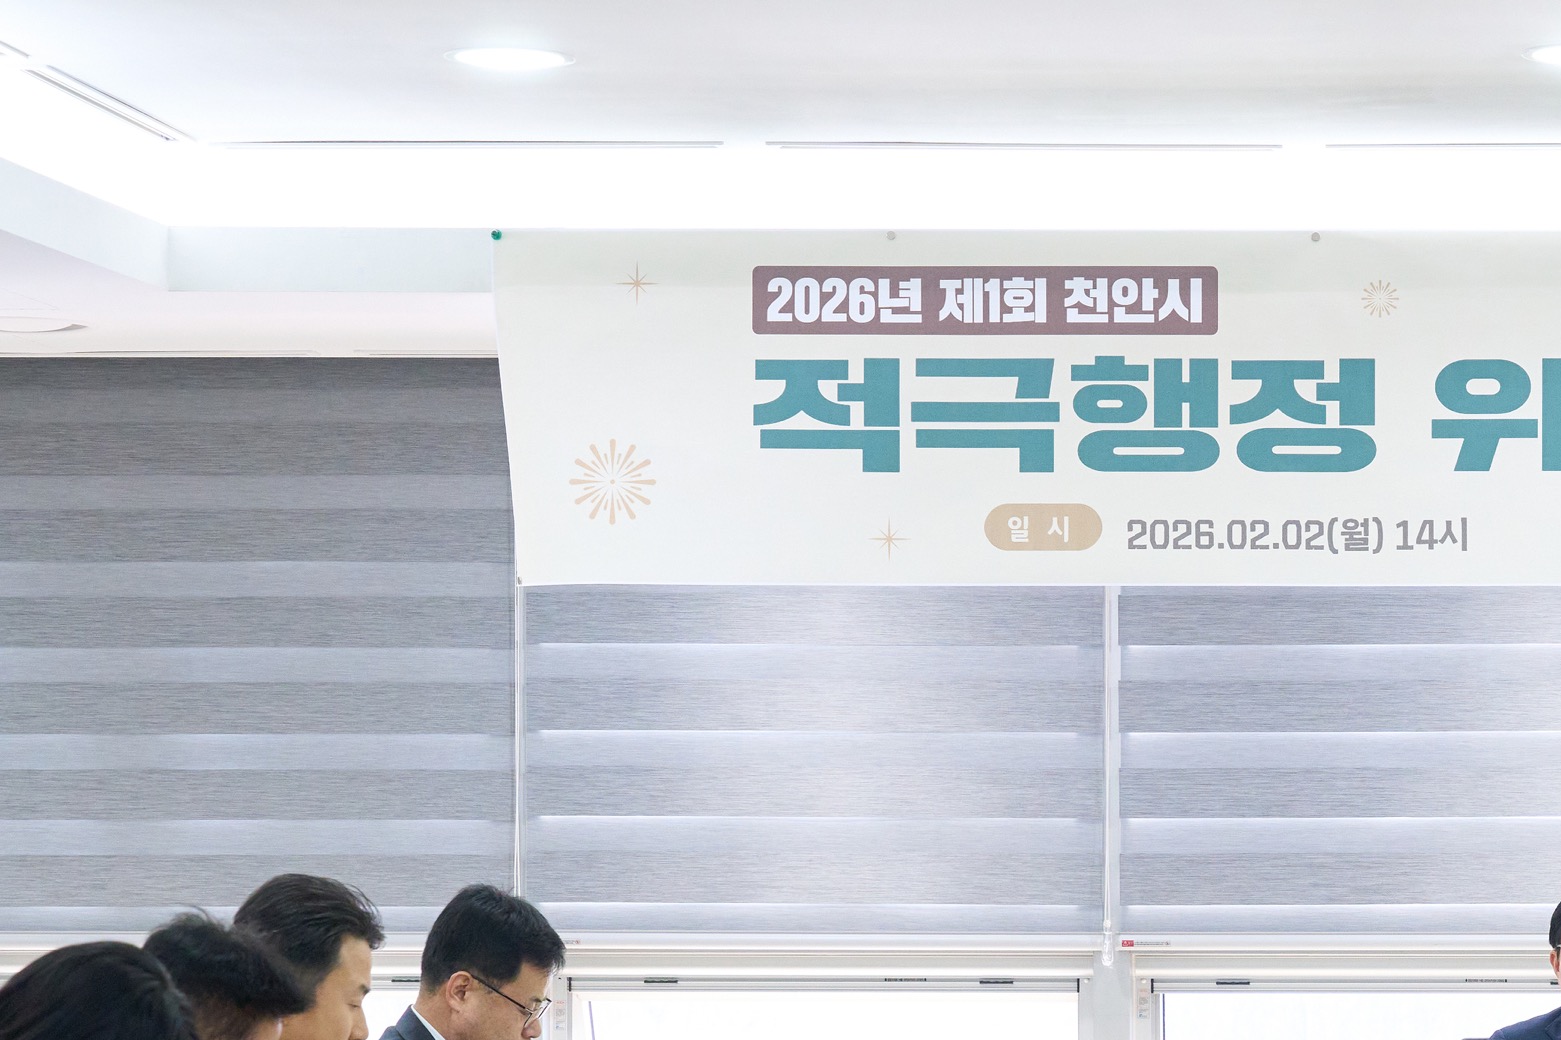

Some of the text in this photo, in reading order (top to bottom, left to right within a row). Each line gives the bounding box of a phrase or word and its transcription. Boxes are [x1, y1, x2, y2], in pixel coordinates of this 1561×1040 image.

[767, 276, 1203, 323] 2026년 제1회 천안시
[753, 358, 1377, 473] 적극행정
[1127, 517, 1468, 555] 2026.02.02(월) 14시
